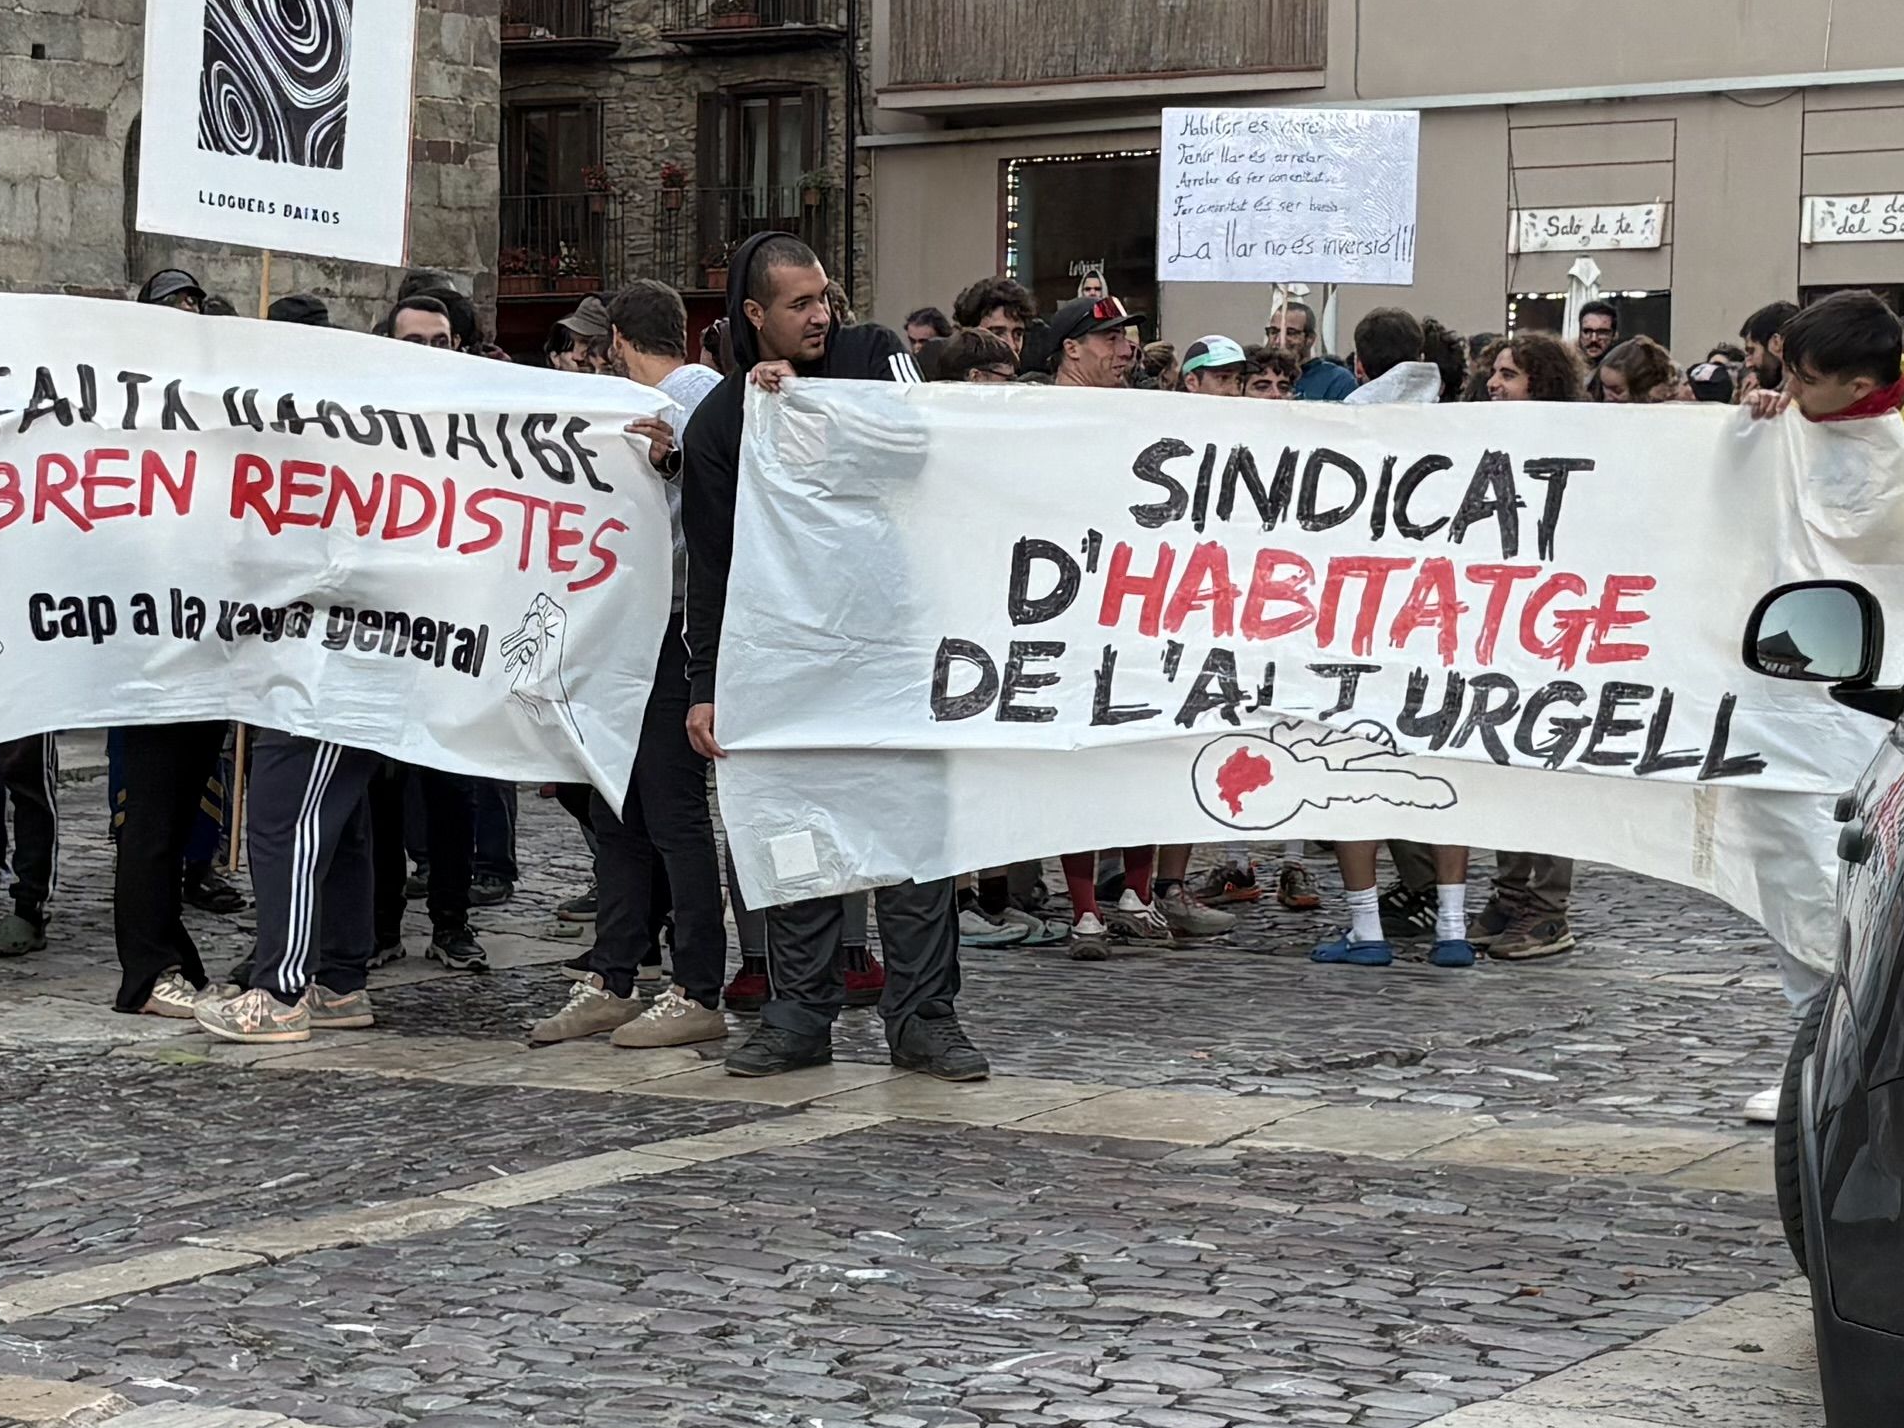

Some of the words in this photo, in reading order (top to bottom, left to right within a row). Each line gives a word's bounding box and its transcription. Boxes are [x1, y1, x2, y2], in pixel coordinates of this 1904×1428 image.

[198, 190, 276, 215] LLOGUERS
[1590, 213, 1608, 234] de
[1836, 215, 1871, 235] del
[1846, 197, 1871, 213] el
[1168, 221, 1211, 263] La
[1225, 219, 1257, 262] llar
[1264, 239, 1286, 255] no
[1291, 234, 1315, 255] és
[230, 455, 630, 593] RENDISTES
[1128, 437, 1595, 561] SINDICAT
[28, 591, 118, 645] Cap
[129, 591, 159, 636] a
[169, 587, 206, 642] la
[215, 600, 315, 643] vaga
[321, 604, 490, 678] general
[1006, 529, 1658, 669] D'HABITATGE
[929, 636, 1067, 723] DE
[1399, 665, 1768, 778] URGELL
